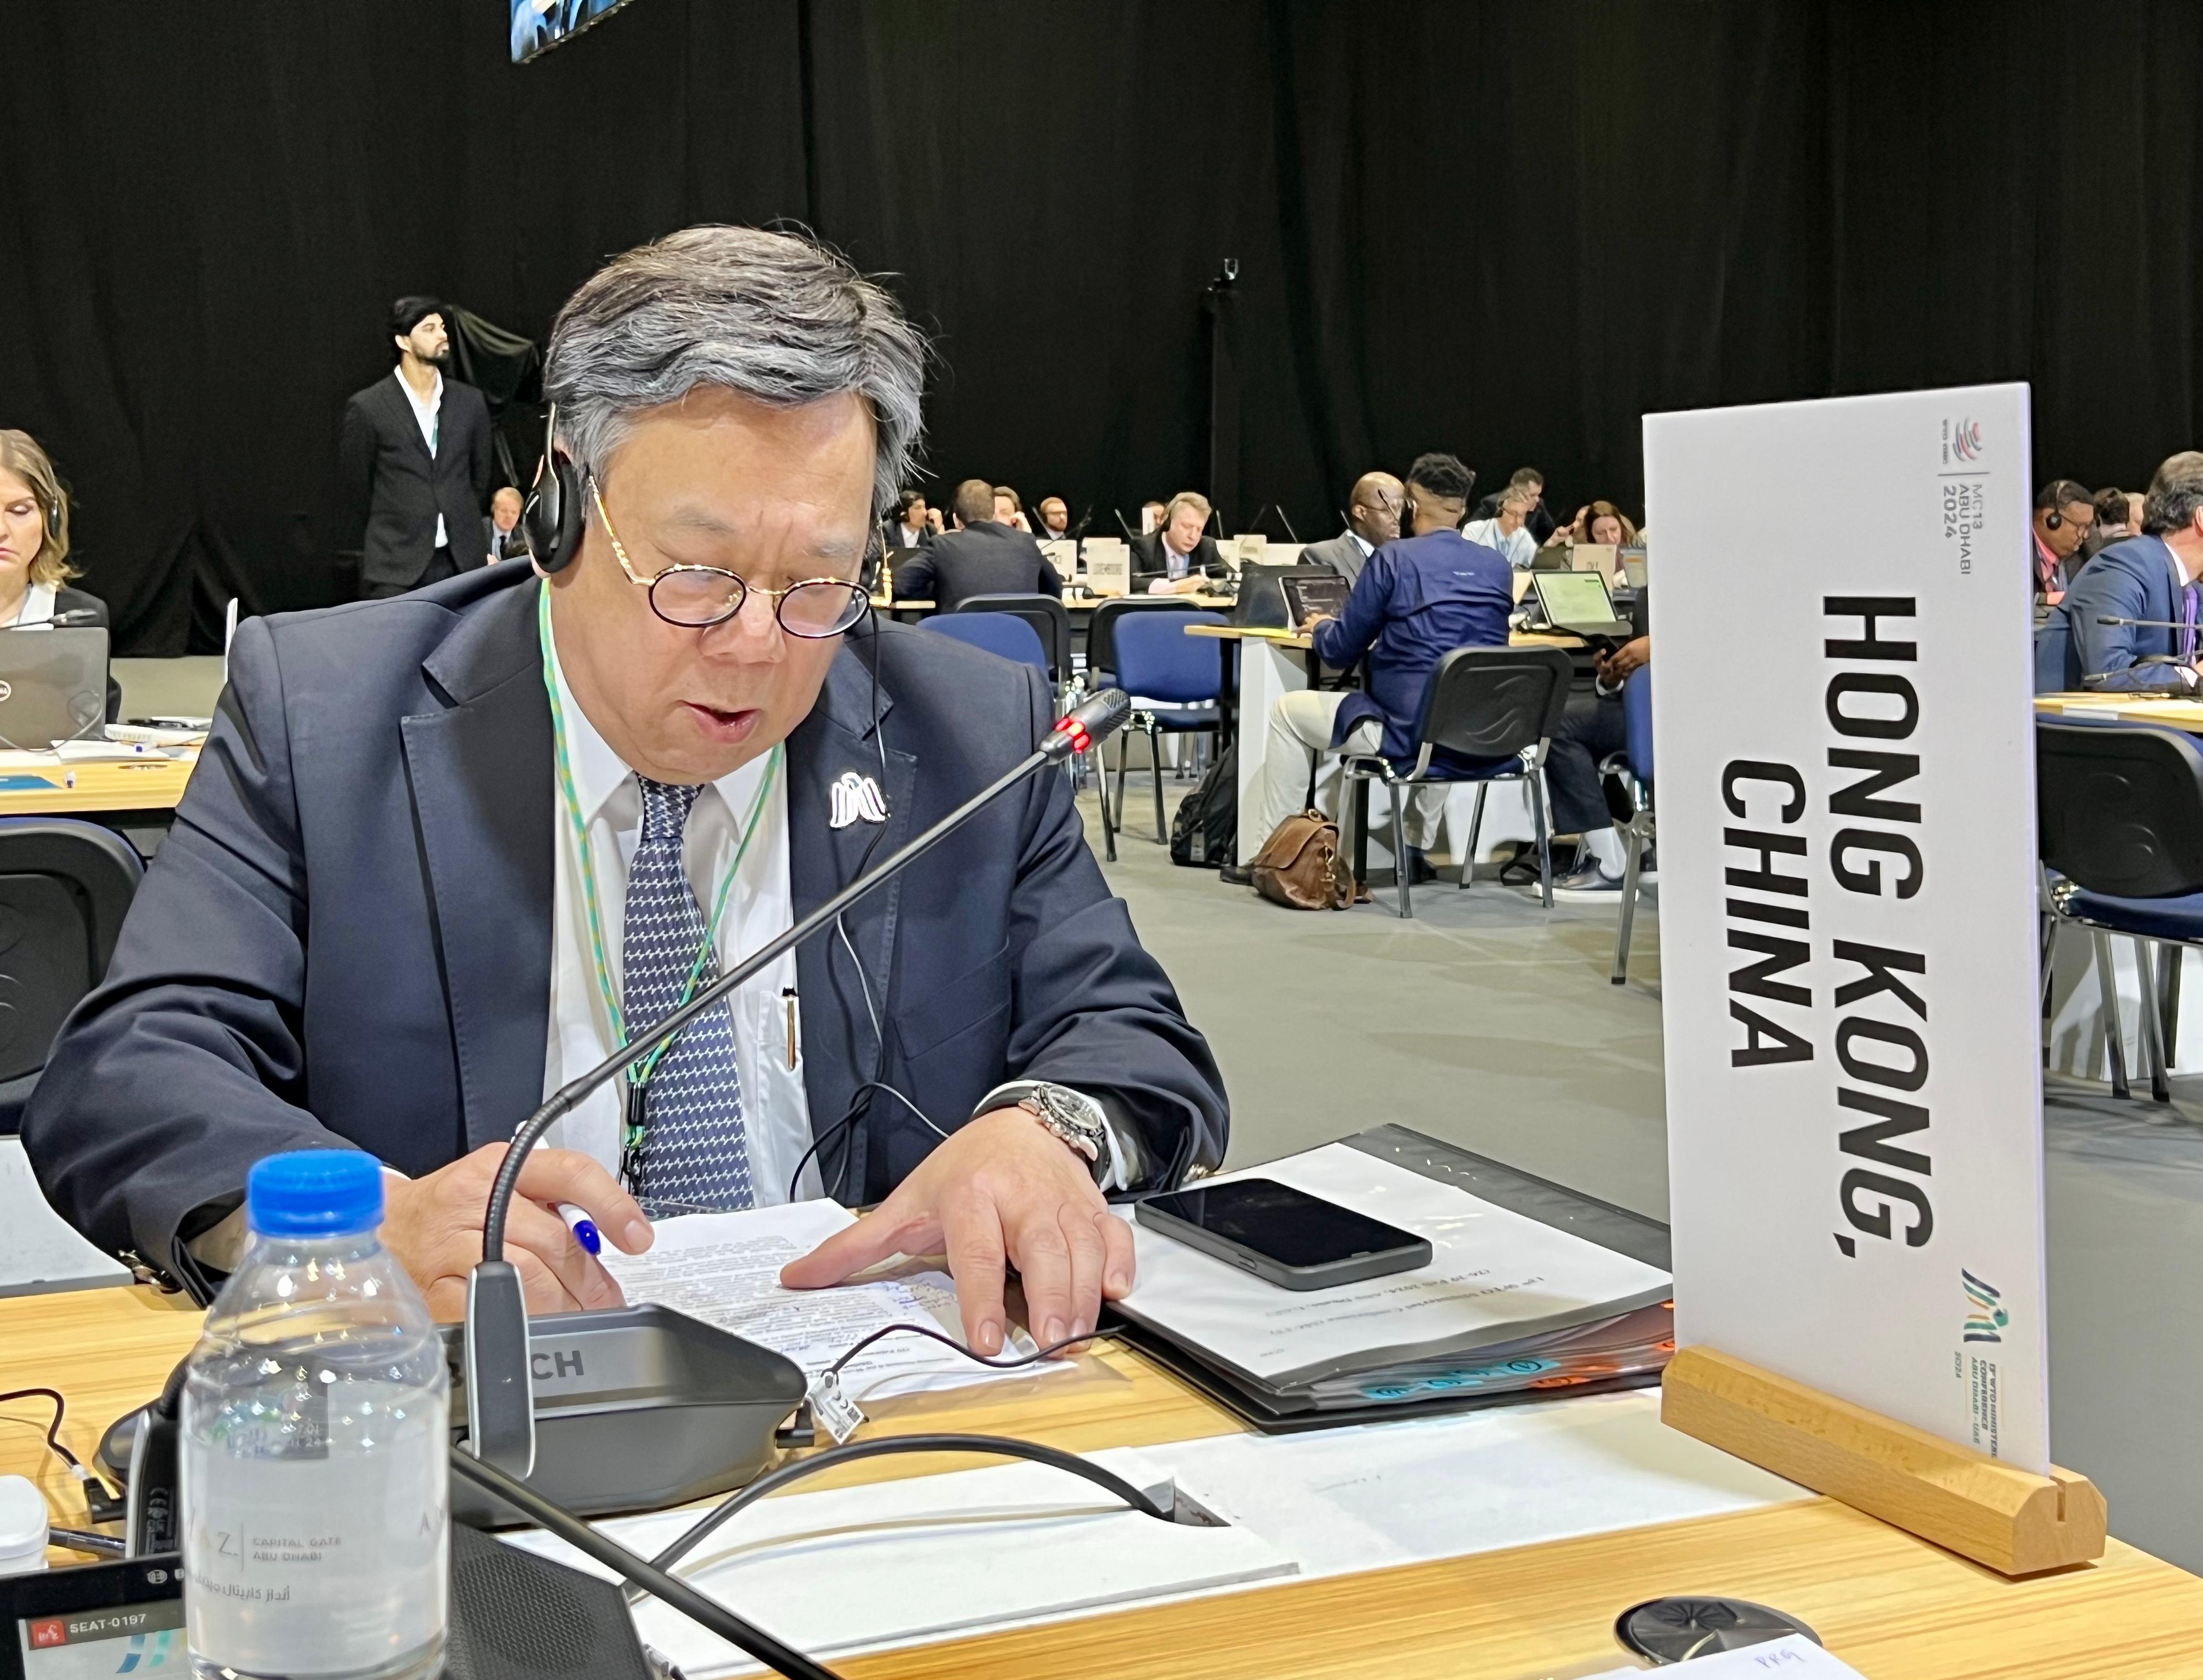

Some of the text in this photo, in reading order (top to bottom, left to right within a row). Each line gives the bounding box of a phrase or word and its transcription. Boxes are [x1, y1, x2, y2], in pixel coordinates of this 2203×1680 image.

[1944, 486, 1957, 538] 2024
[1959, 484, 1971, 574] ABU DHABI
[1972, 484, 1983, 529] MC13
[1721, 759, 1814, 1068] CHINA
[1823, 596, 1934, 1258] HONG KONG,
[253, 1537, 342, 1547] CAPITAL GATE
